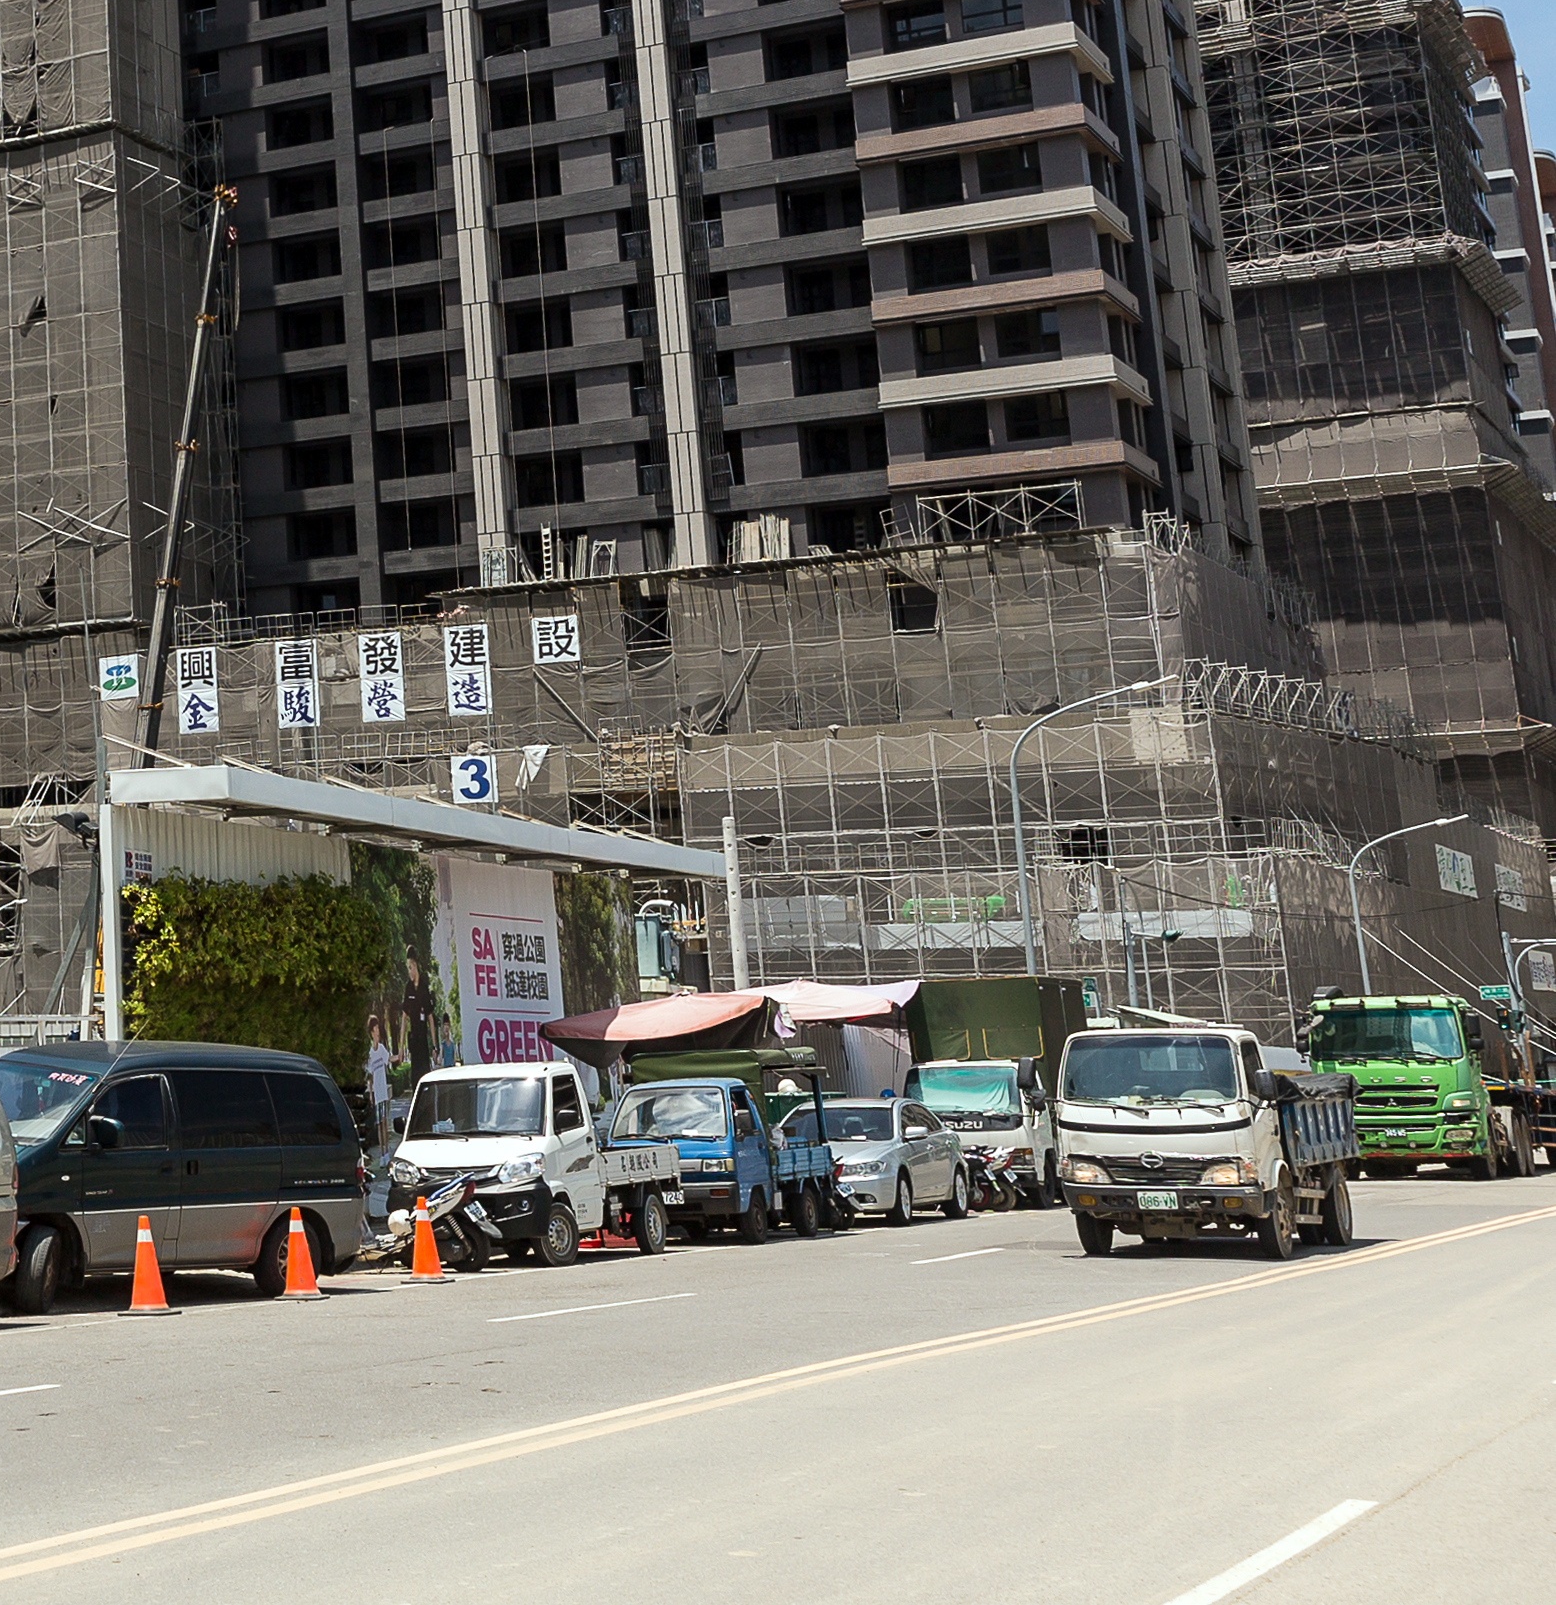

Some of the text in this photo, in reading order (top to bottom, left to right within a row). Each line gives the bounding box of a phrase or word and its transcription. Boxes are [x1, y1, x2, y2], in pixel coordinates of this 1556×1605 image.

[180, 619, 577, 688] 興富發建設
[459, 758, 490, 800] 3
[471, 927, 495, 961] SA
[501, 931, 547, 965] 穿過公園
[474, 964, 499, 997] FE
[942, 1120, 984, 1130] SUZU
